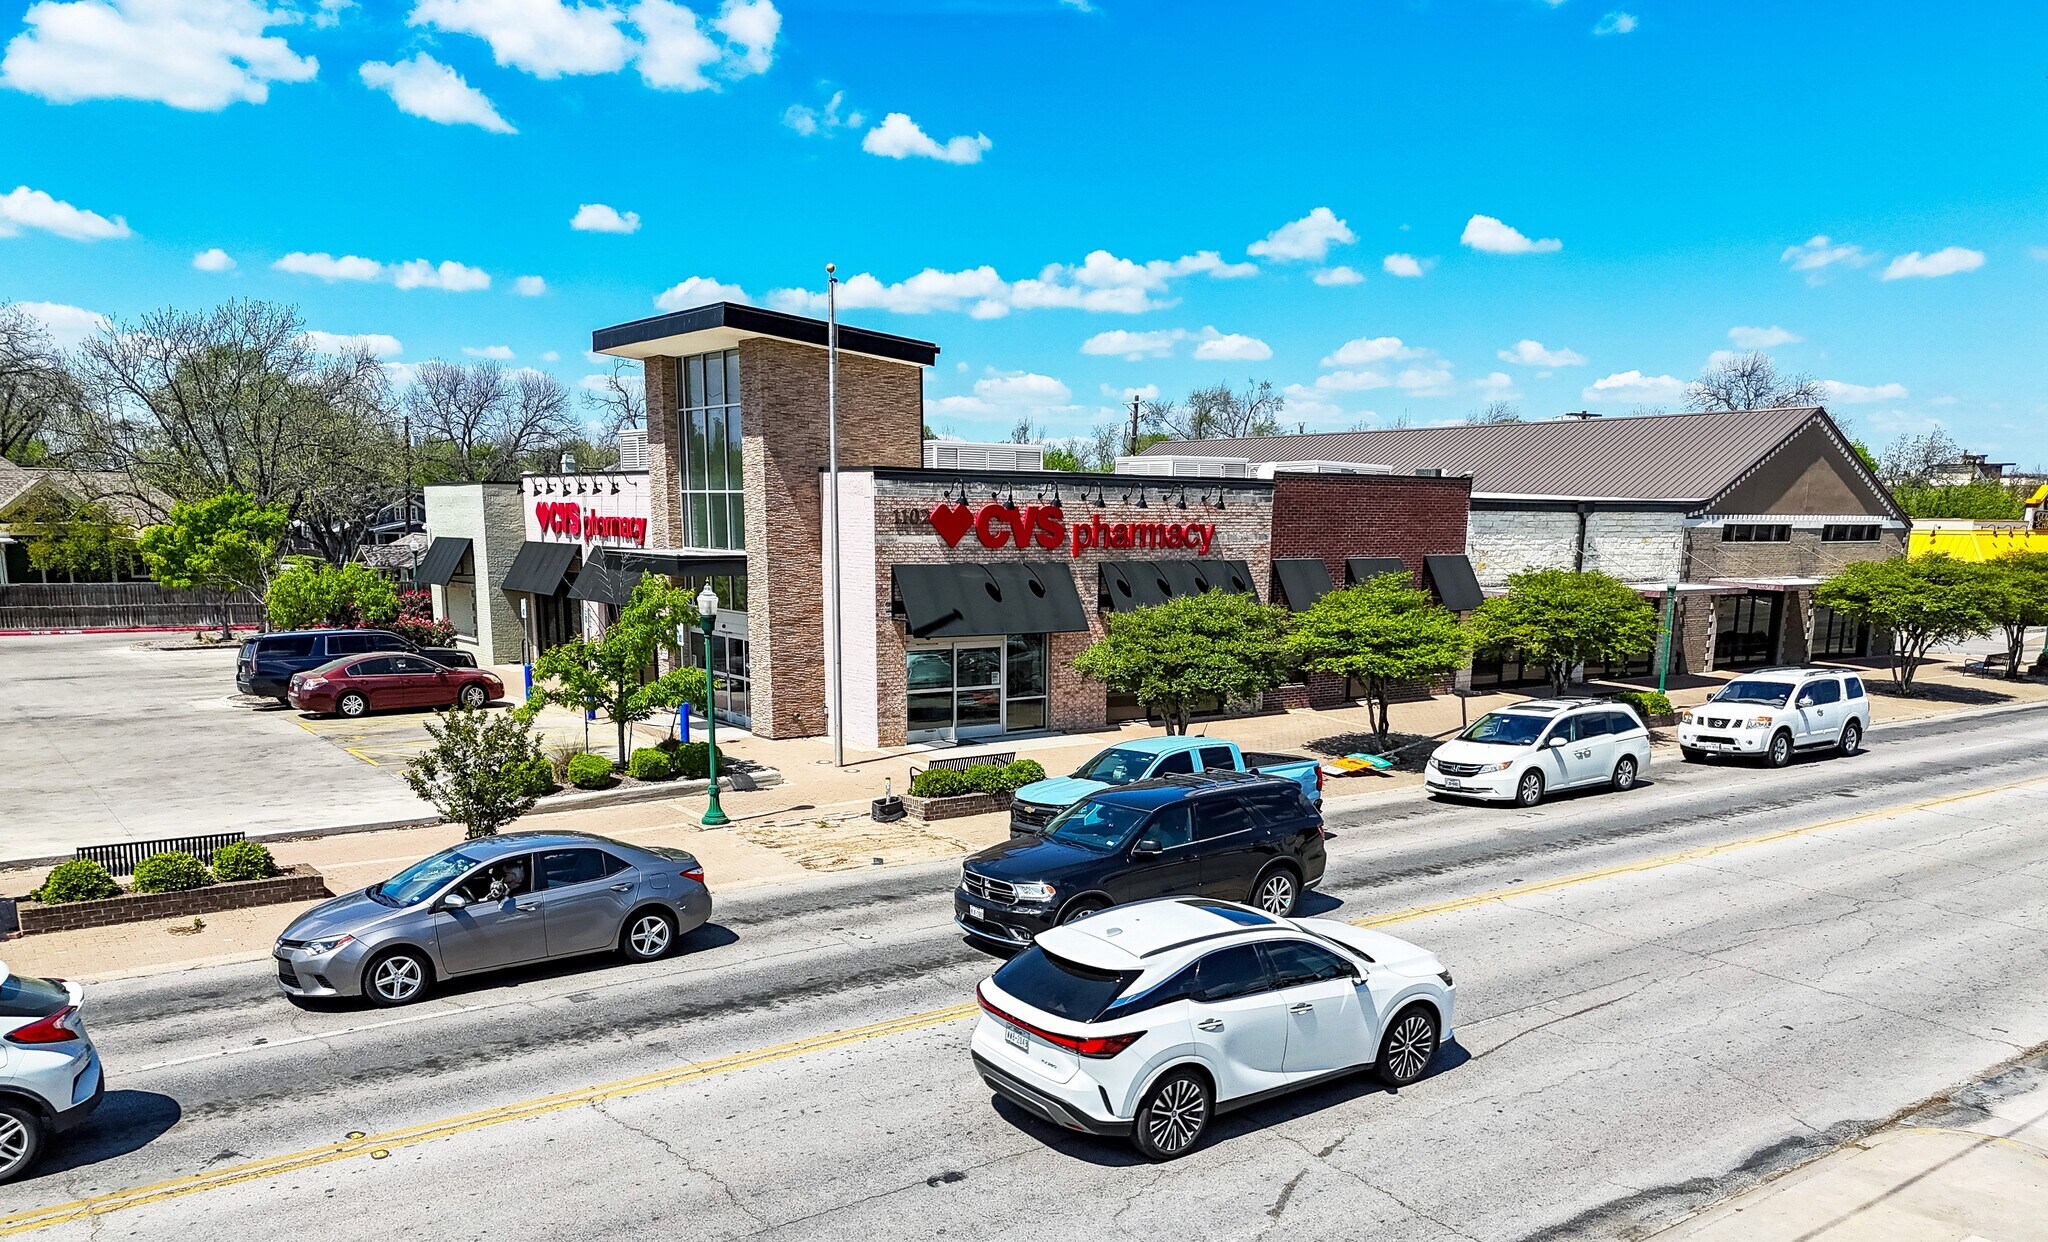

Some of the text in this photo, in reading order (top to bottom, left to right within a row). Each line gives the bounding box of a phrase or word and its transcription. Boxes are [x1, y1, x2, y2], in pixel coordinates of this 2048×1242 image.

[550, 502, 647, 547] CVS pharmacy
[975, 503, 1215, 558] CVS pharmacy
